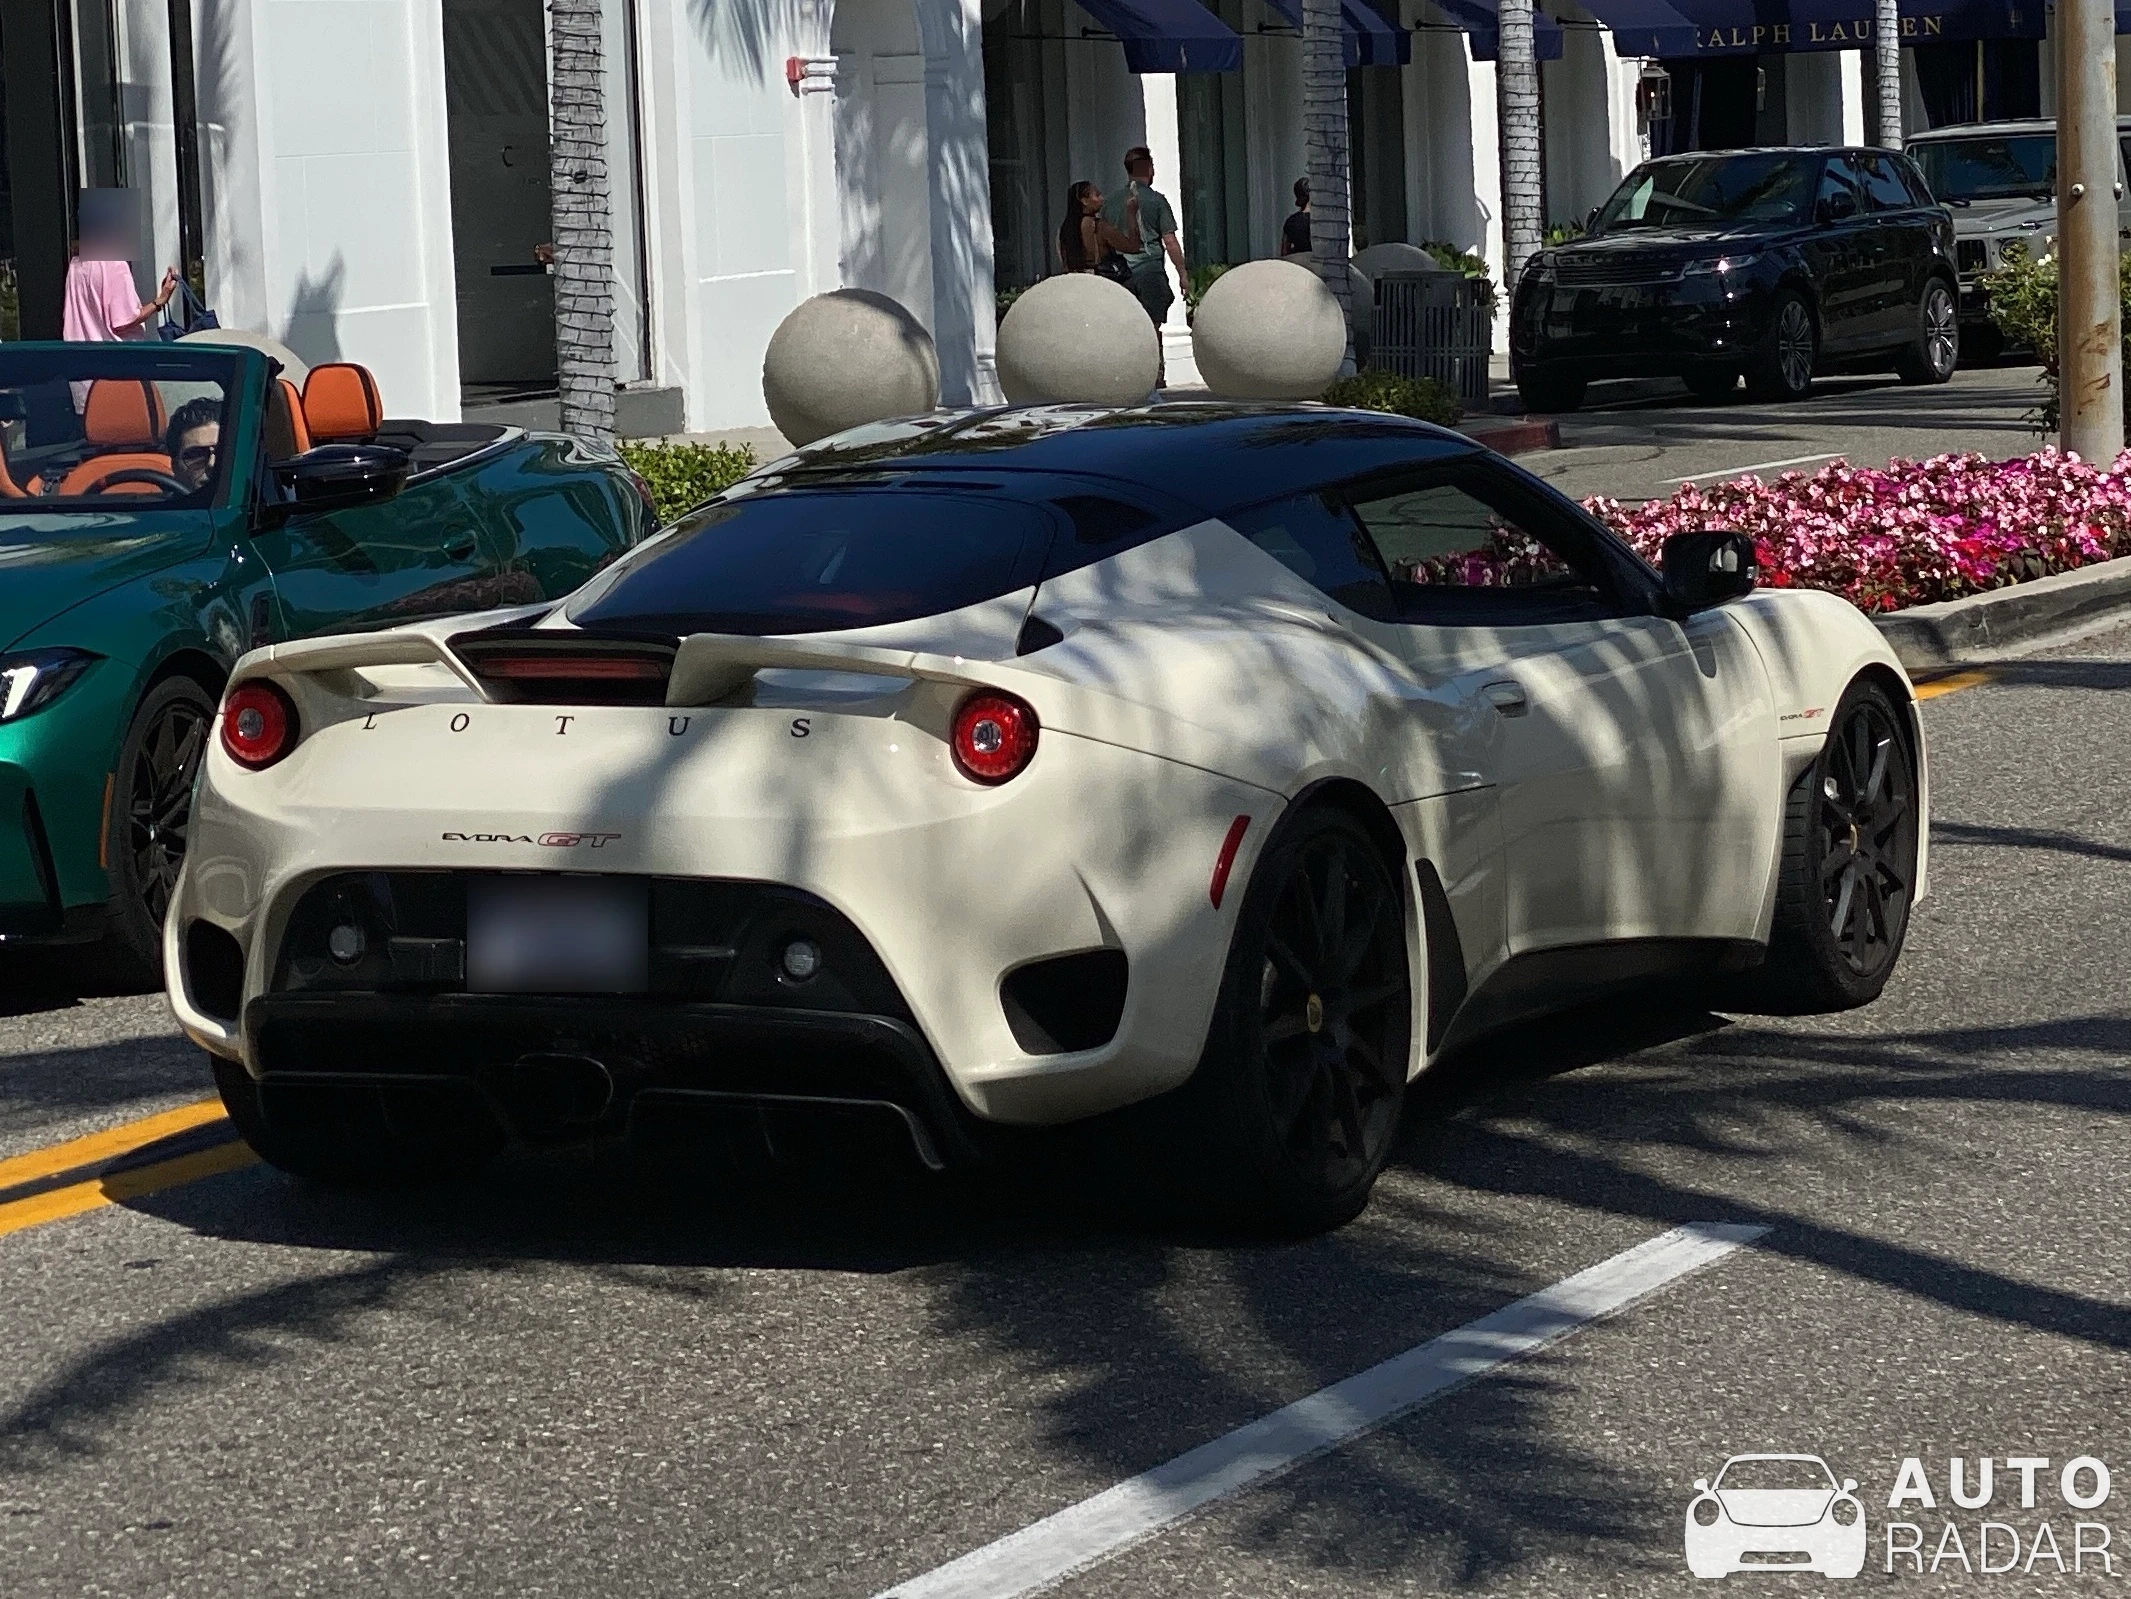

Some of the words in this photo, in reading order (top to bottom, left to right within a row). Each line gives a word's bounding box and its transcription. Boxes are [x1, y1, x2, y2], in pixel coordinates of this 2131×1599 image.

[1810, 16, 1942, 42] LAUEN
[362, 711, 811, 739] LOTUS
[442, 832, 534, 844] EVORA
[537, 832, 622, 848] GT
